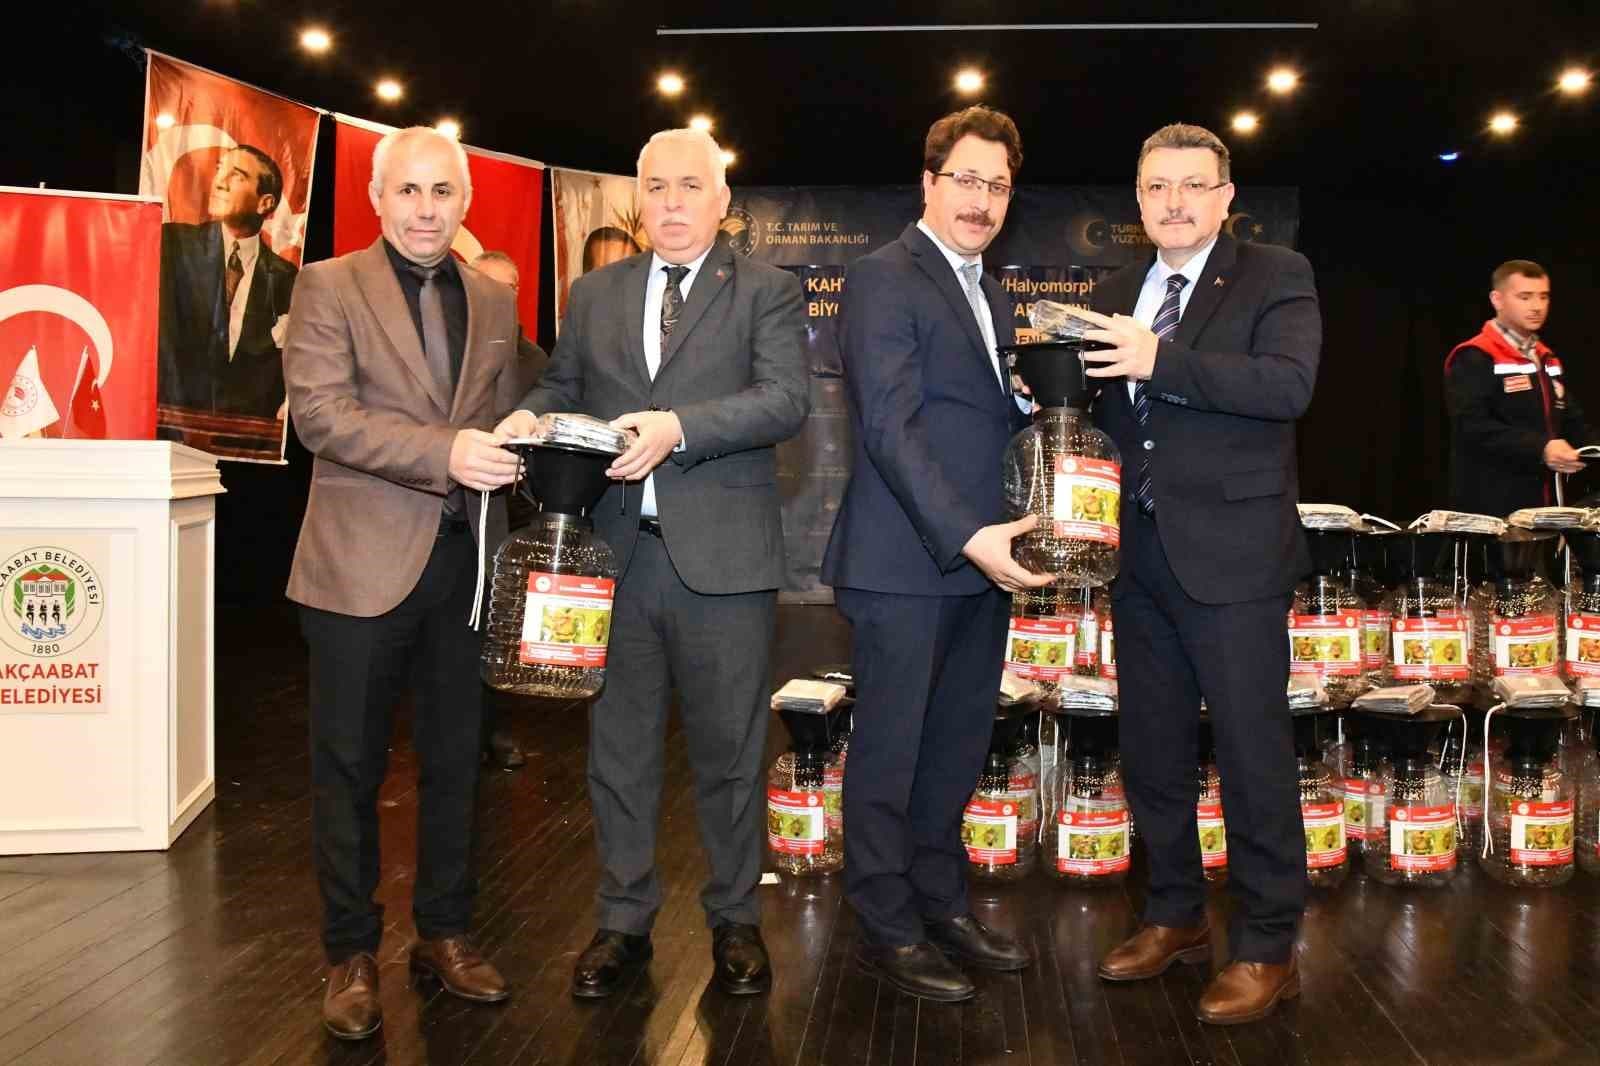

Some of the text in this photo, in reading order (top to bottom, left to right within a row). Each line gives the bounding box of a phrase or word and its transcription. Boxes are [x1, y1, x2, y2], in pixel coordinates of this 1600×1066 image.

[766, 222, 839, 232] T.C. TARIM VE
[766, 232, 869, 245] ORMAN BAKANLIĞI
[808, 277, 846, 292] KAH
[32, 643, 60, 654] 1880
[0, 663, 99, 682] KÇAABAT
[0, 684, 102, 704] ELEDİYESİ
